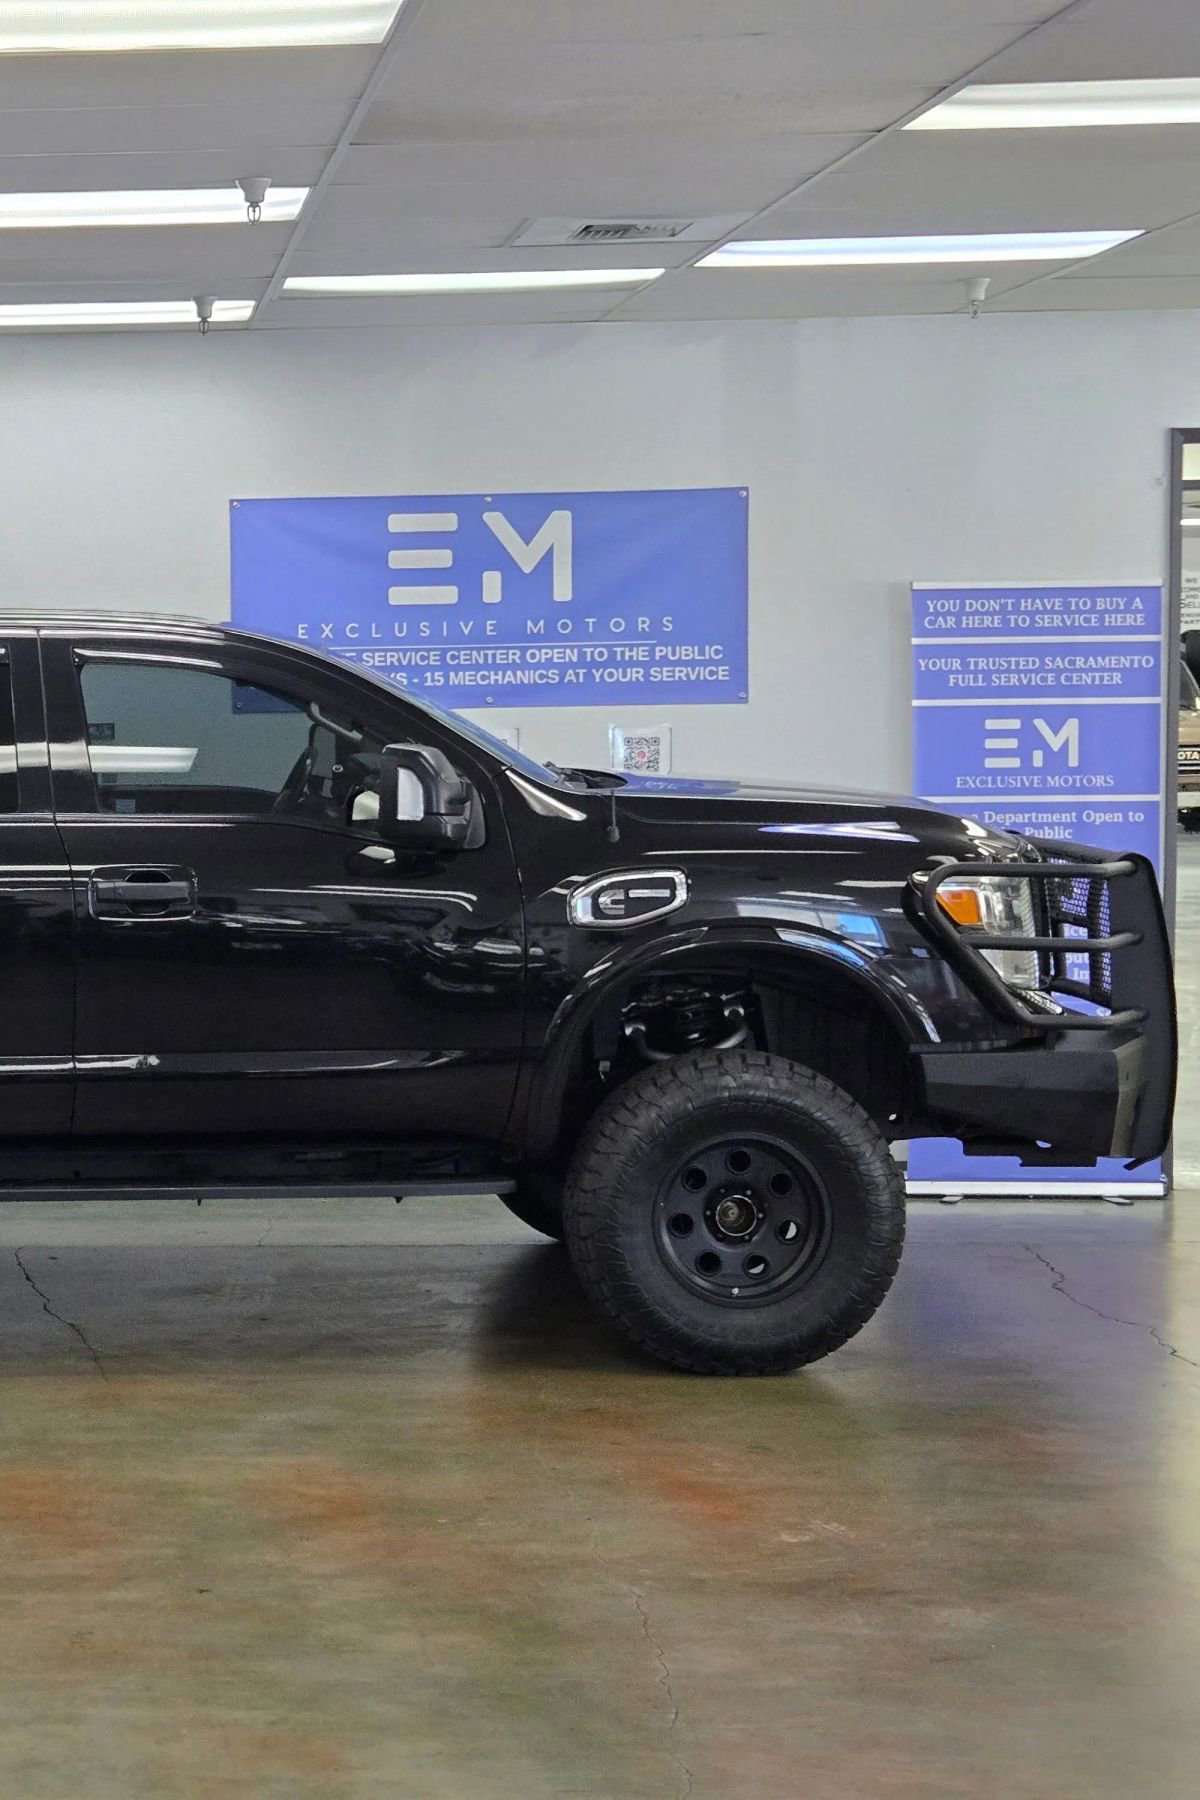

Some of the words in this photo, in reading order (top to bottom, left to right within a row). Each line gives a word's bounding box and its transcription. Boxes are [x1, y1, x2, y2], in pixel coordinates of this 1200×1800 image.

[926, 599, 960, 611] YOU
[965, 599, 1016, 611] DON'T
[1020, 598, 1063, 611] HAVE
[1068, 598, 1090, 610] TO
[1095, 597, 1126, 610] BUY
[1129, 597, 1144, 610] A
[297, 620, 497, 639] EXCLUSIVE
[527, 616, 673, 635] MOTORS
[924, 616, 957, 629] CAR
[961, 615, 1002, 628] HERE
[1006, 614, 1030, 627] TO
[1034, 614, 1099, 627] SERVICE
[1103, 613, 1146, 626] HERE
[361, 651, 441, 666] SERVICE
[446, 649, 521, 665] CENTER
[526, 648, 578, 663] OPEN
[582, 647, 608, 662] TO
[613, 646, 650, 661] THE
[655, 645, 723, 660] PUBLIC
[918, 657, 962, 671] YOUR
[967, 657, 1040, 670] TRUSTED
[1044, 655, 1154, 669] SACRAMENTO
[423, 671, 445, 686] 15
[449, 669, 559, 686] MECHANICS
[563, 669, 587, 683] AT
[592, 667, 644, 683] YOUR
[649, 666, 730, 682] SERVICE
[949, 674, 987, 687] FULL
[991, 673, 1056, 686] SERVICE
[1060, 672, 1122, 686] CENTER
[956, 775, 1043, 788] EXCLUSIVE
[1046, 775, 1114, 788] MOTORS
[983, 811, 1077, 826] Department
[1082, 810, 1123, 825] Open
[1128, 811, 1145, 824] to
[1025, 826, 1073, 839] Public
